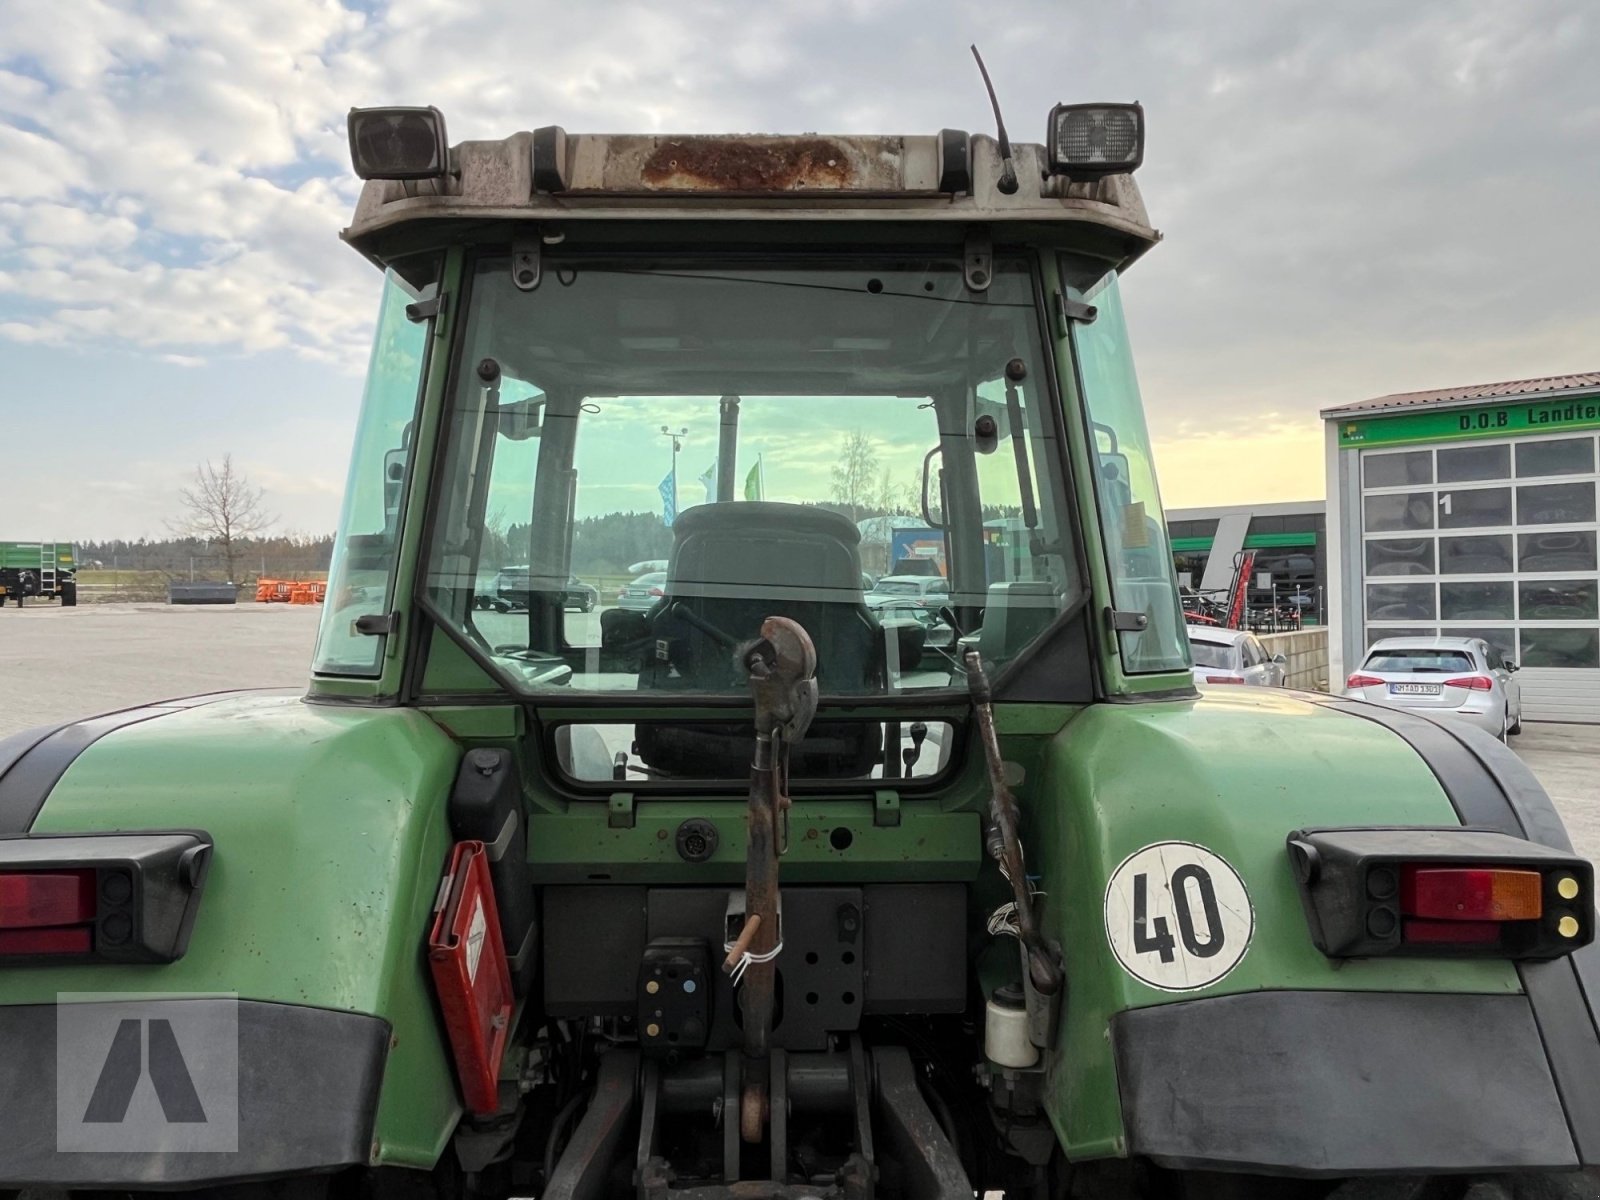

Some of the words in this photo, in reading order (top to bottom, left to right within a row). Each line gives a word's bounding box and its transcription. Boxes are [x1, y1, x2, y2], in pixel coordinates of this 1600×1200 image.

[1460, 411, 1508, 430] D.O.B
[1528, 404, 1600, 425] Landte
[1439, 493, 1452, 515] 1
[1133, 863, 1225, 964] 40
